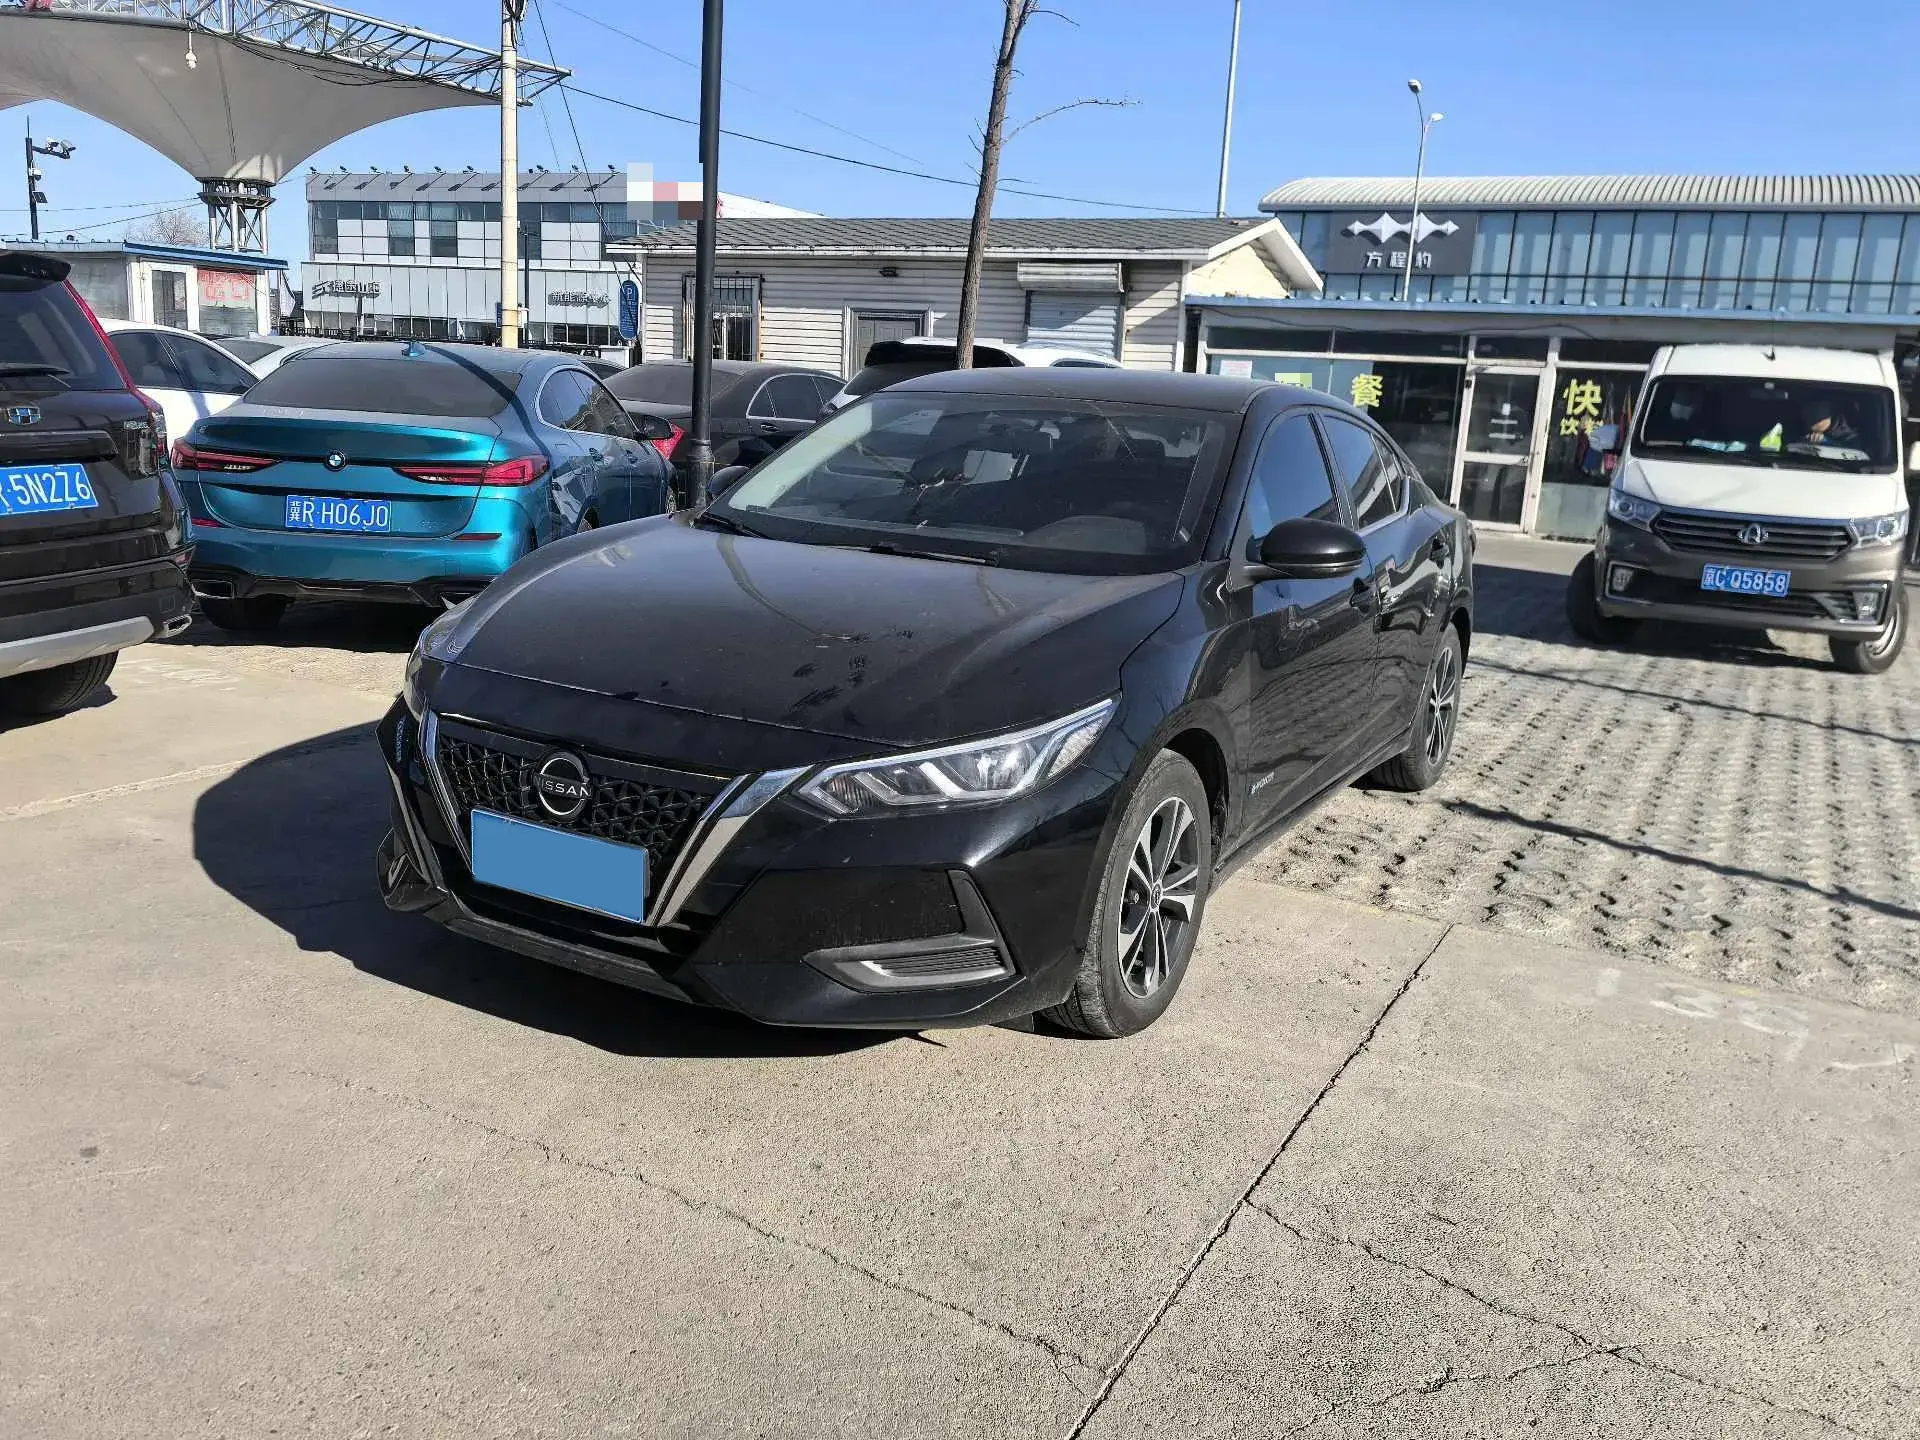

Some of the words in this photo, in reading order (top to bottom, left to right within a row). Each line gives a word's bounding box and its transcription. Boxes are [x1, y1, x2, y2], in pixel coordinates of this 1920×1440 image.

[1366, 251, 1432, 269] 方程豹
[1352, 373, 1384, 408] 餐
[1562, 378, 1602, 416] 快
[534, 774, 592, 797] NISSAN
